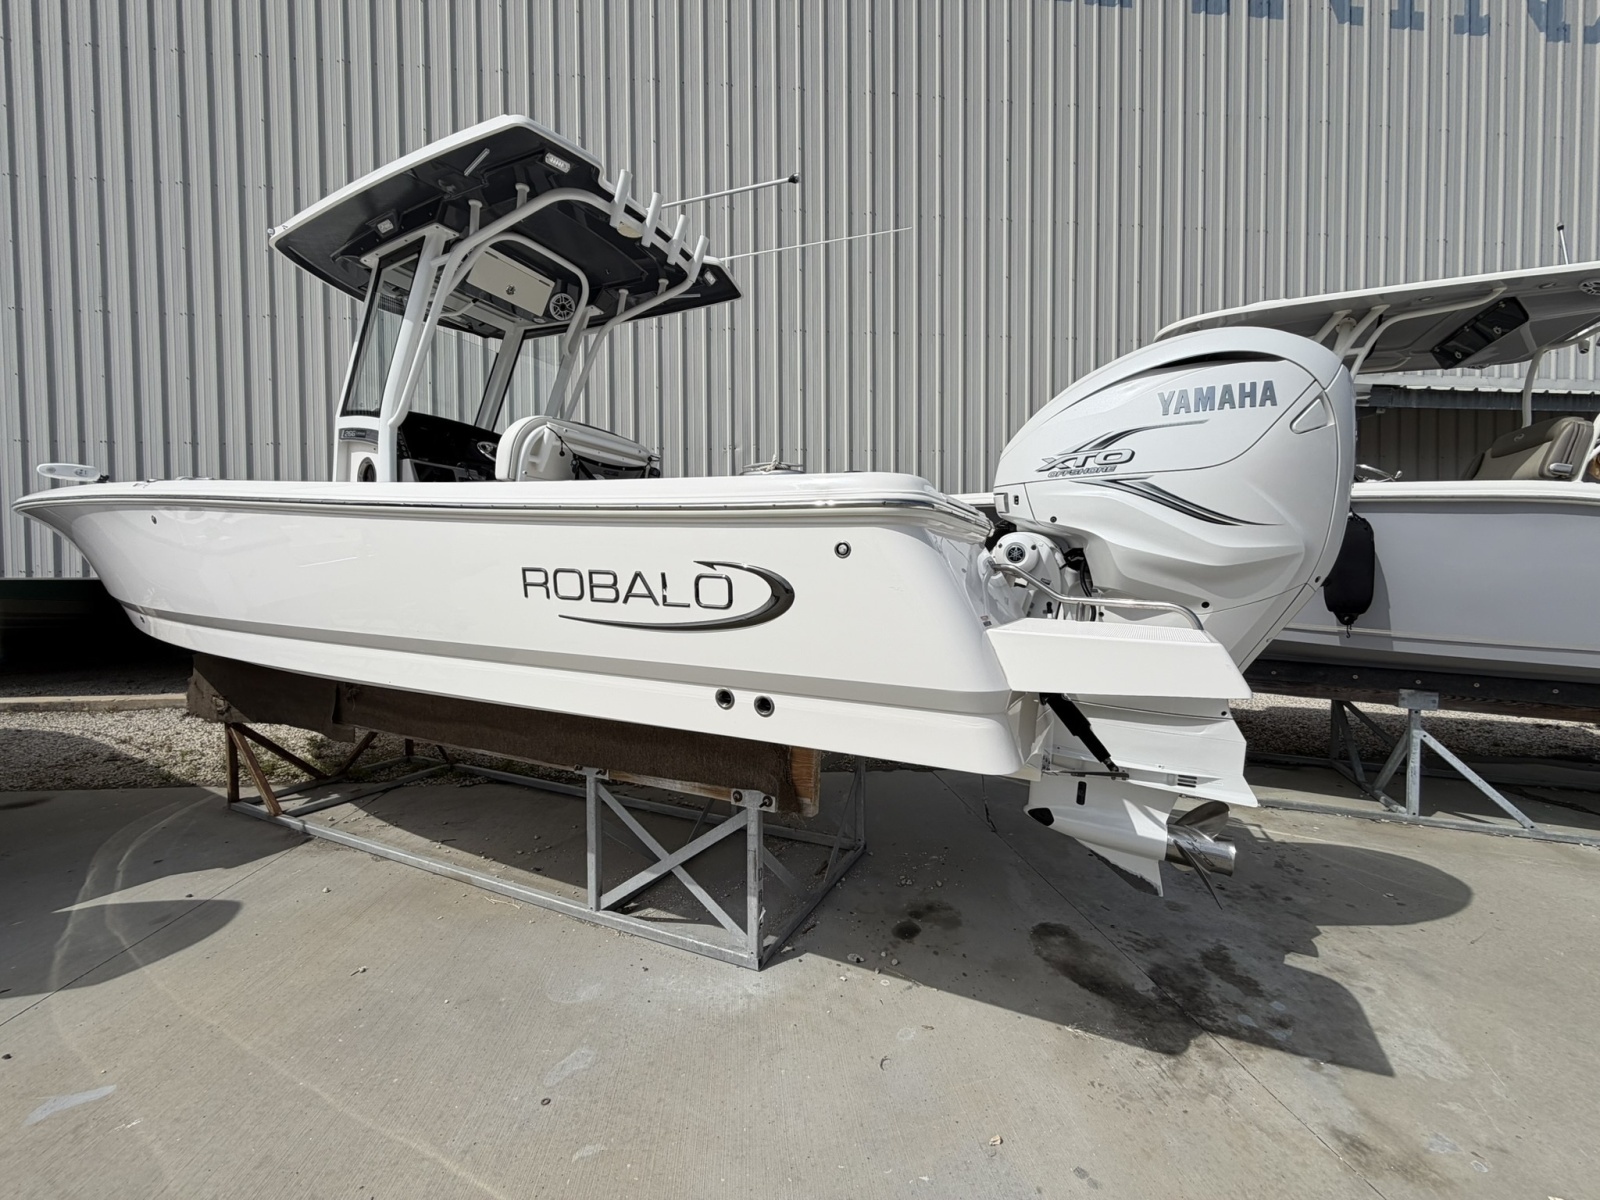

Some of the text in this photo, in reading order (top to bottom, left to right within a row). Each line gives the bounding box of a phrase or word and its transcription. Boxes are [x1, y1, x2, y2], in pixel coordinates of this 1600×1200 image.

[1157, 380, 1278, 416] YAMAHA
[1035, 448, 1136, 472] XTO
[1047, 464, 1118, 478] OFFSHORE
[521, 566, 733, 610] ROBALO
